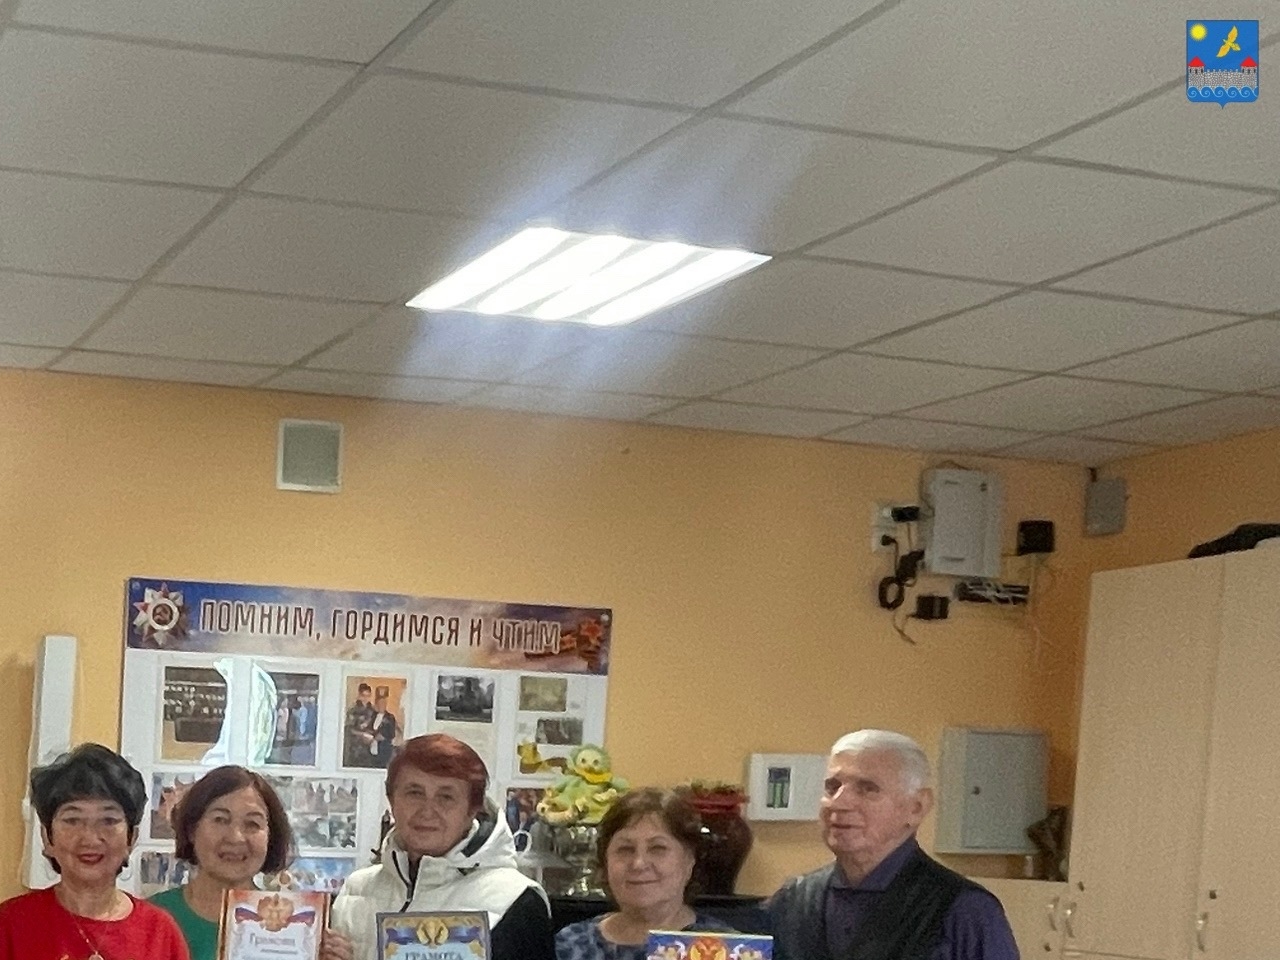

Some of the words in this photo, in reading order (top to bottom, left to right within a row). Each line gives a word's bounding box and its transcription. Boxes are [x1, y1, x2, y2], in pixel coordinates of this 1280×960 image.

[201, 600, 321, 641] ПОМНИМ,
[331, 609, 460, 647] ГОРДИМСЯ
[470, 617, 483, 647] И
[492, 617, 561, 655] ЧТИМ
